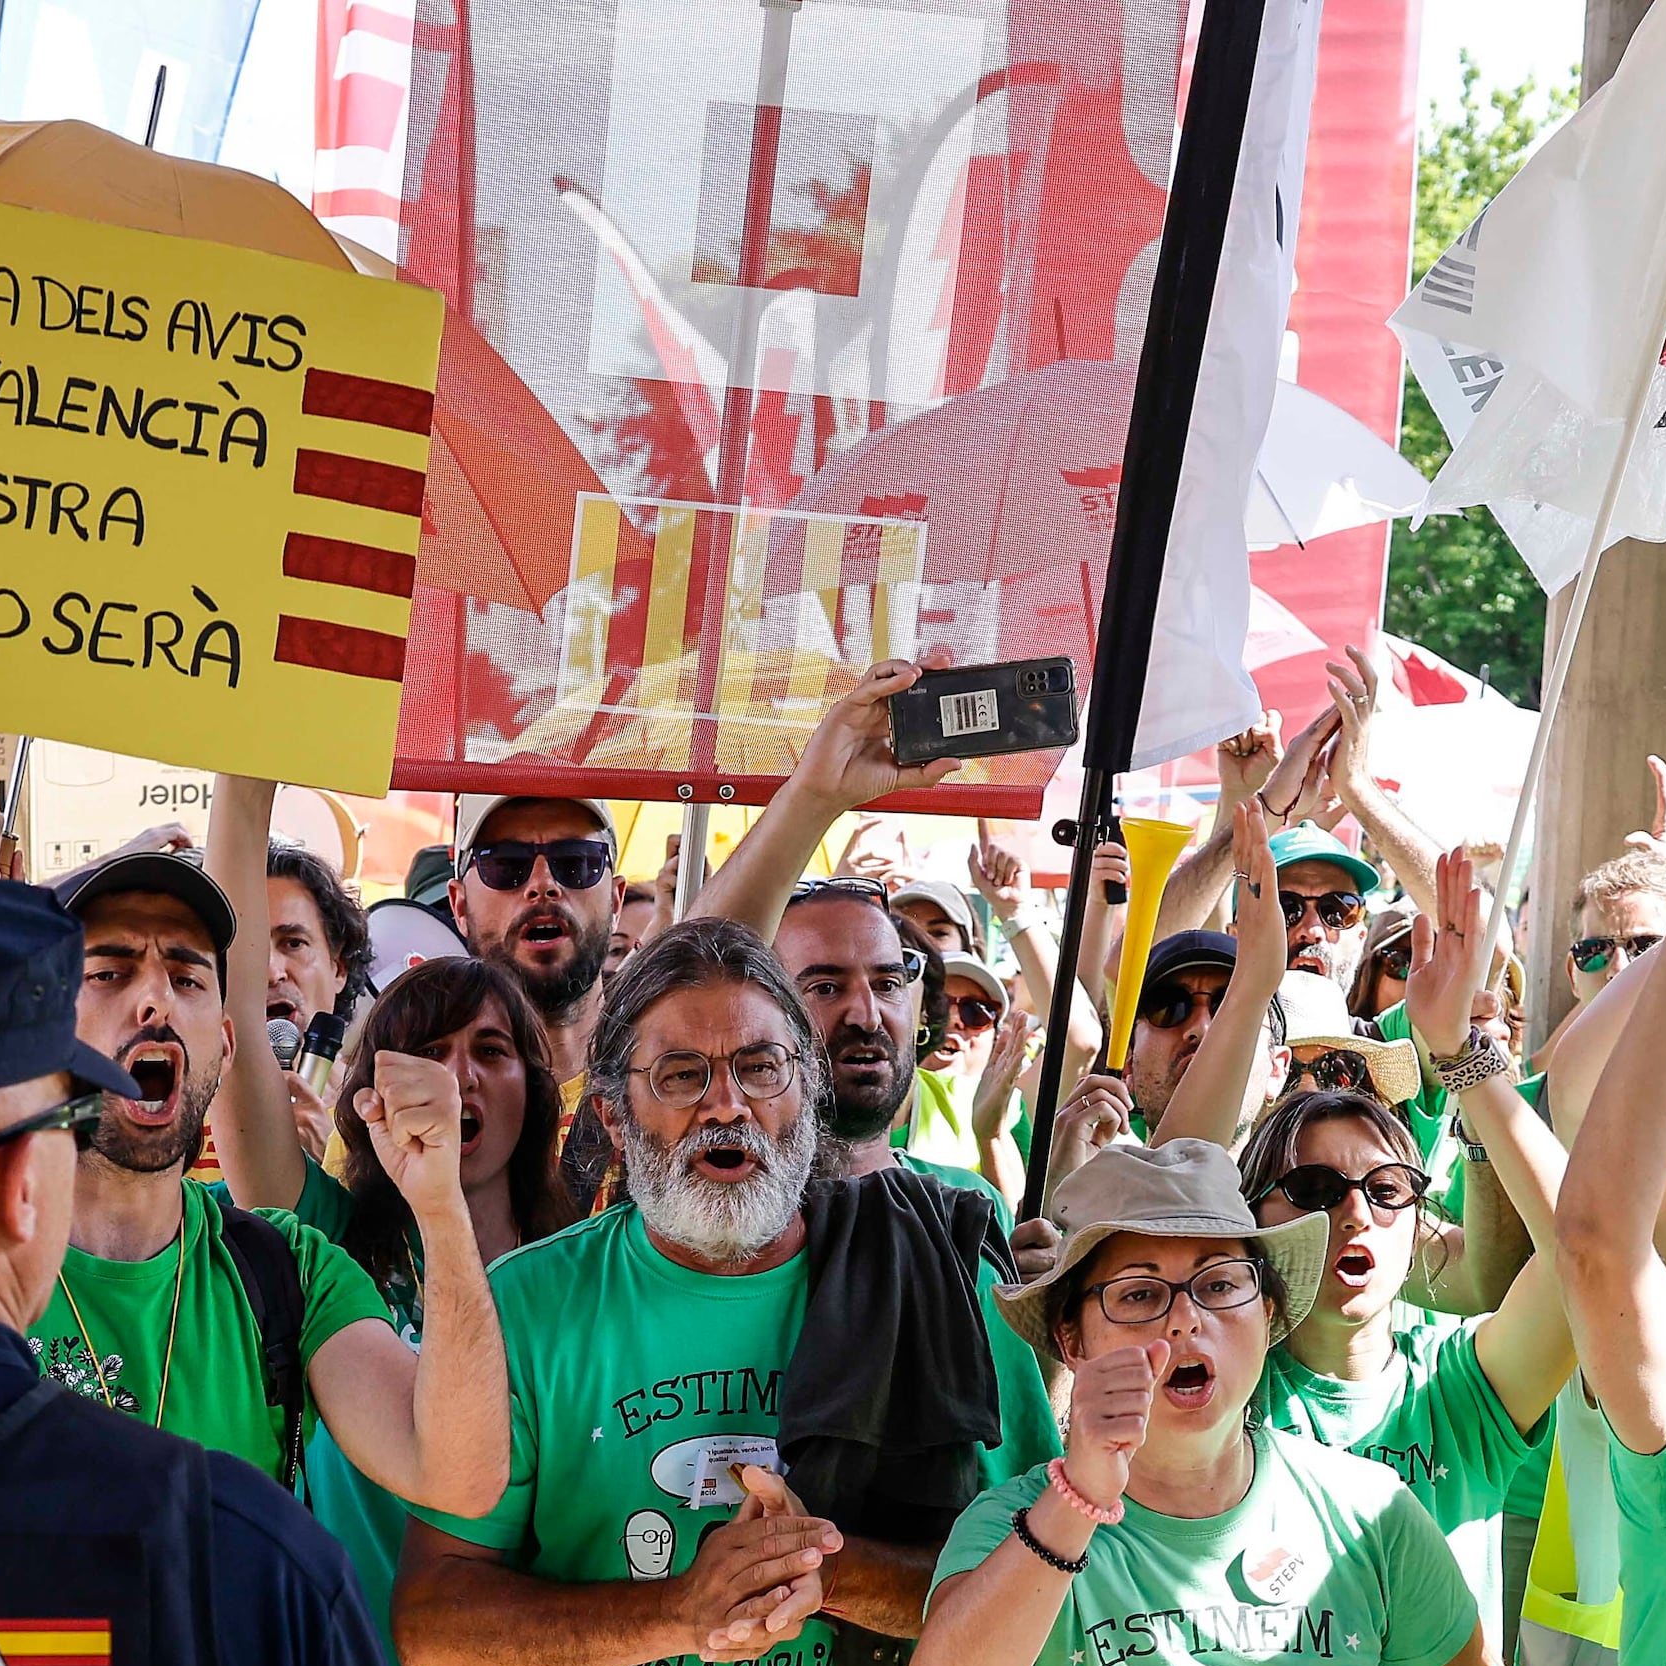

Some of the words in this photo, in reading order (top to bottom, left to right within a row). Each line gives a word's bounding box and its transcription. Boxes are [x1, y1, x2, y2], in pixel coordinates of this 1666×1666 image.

[32, 276, 149, 341] DELS
[167, 301, 307, 372] AVIS
[42, 586, 240, 688] SERÀ
[612, 1367, 784, 1440] ESTIM
[1269, 1553, 1305, 1596] STEPV
